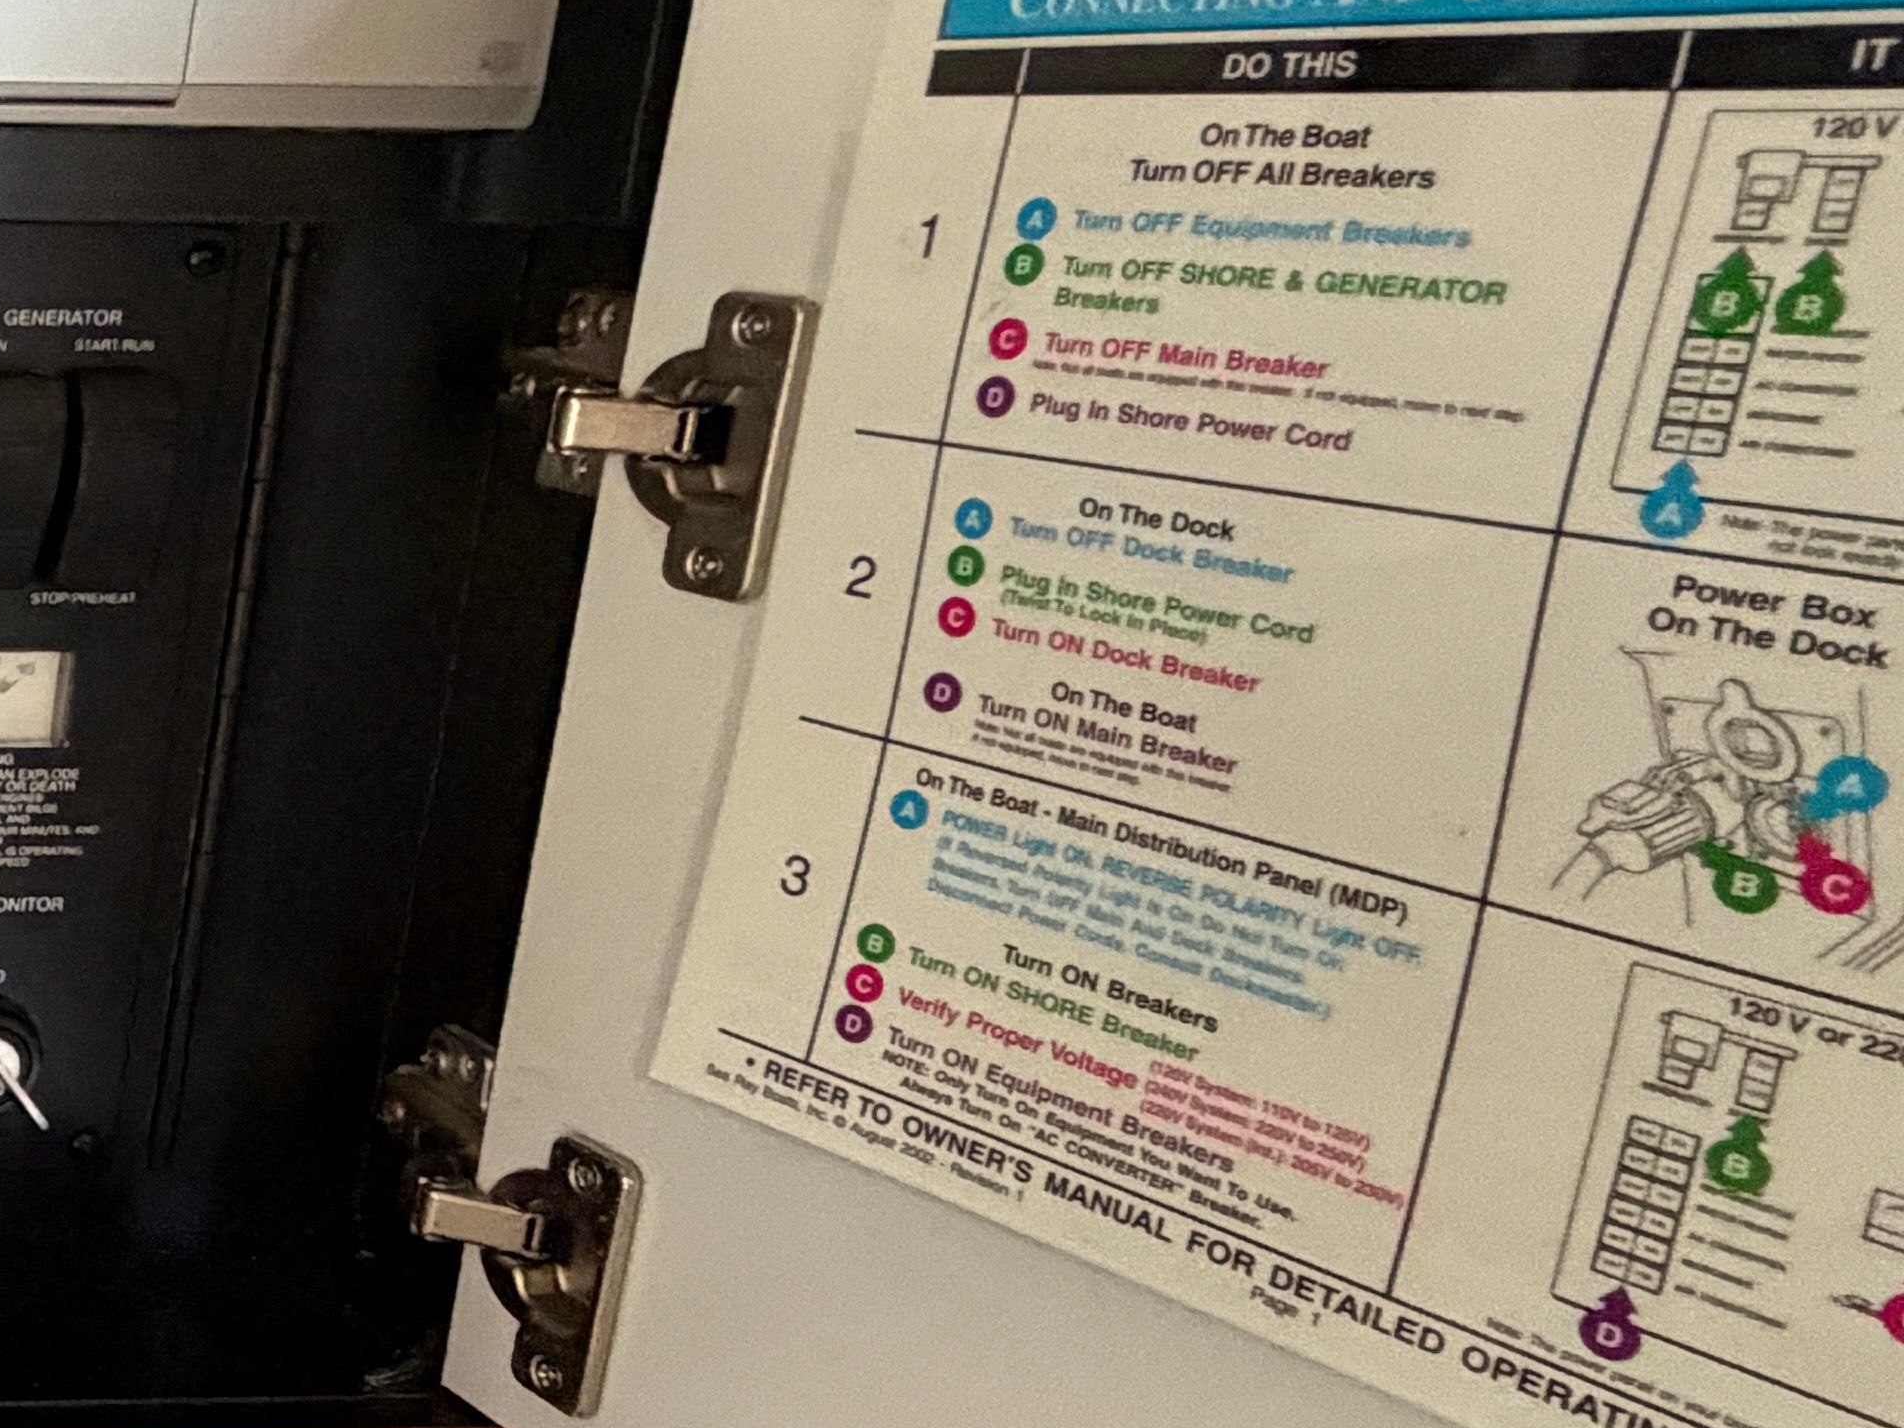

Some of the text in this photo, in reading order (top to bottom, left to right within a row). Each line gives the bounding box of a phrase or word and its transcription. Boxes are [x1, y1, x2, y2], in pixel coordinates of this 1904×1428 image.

[1223, 51, 1359, 80] DO THIS
[1849, 38, 1899, 70] IT
[1200, 123, 1373, 149] On The Boat
[1130, 160, 1436, 189] Turn OFF All Breakers
[919, 214, 940, 258] 1
[4, 309, 123, 328] GENERATOR
[999, 330, 1331, 379] C Turn OFF Main Breaker
[1030, 393, 1080, 423] Plug
[1117, 404, 1190, 430] Shore
[1197, 412, 1279, 443] Power
[1285, 423, 1353, 451] Cord
[1079, 497, 1235, 542] On The Dock
[845, 555, 878, 600] 2
[1673, 574, 1876, 629] Power Box
[1648, 608, 1889, 670] On The Dock
[781, 854, 811, 897] 3
[1002, 943, 1218, 1034] Turn ON Breakers
[763, 1058, 848, 1111] REFER
[857, 1094, 893, 1126] TO
[901, 1108, 1036, 1184] OWNER'S
[1042, 1172, 1174, 1243] MANUAL
[1183, 1230, 1257, 1278] FOR
[1266, 1263, 1446, 1358] DETAILED
